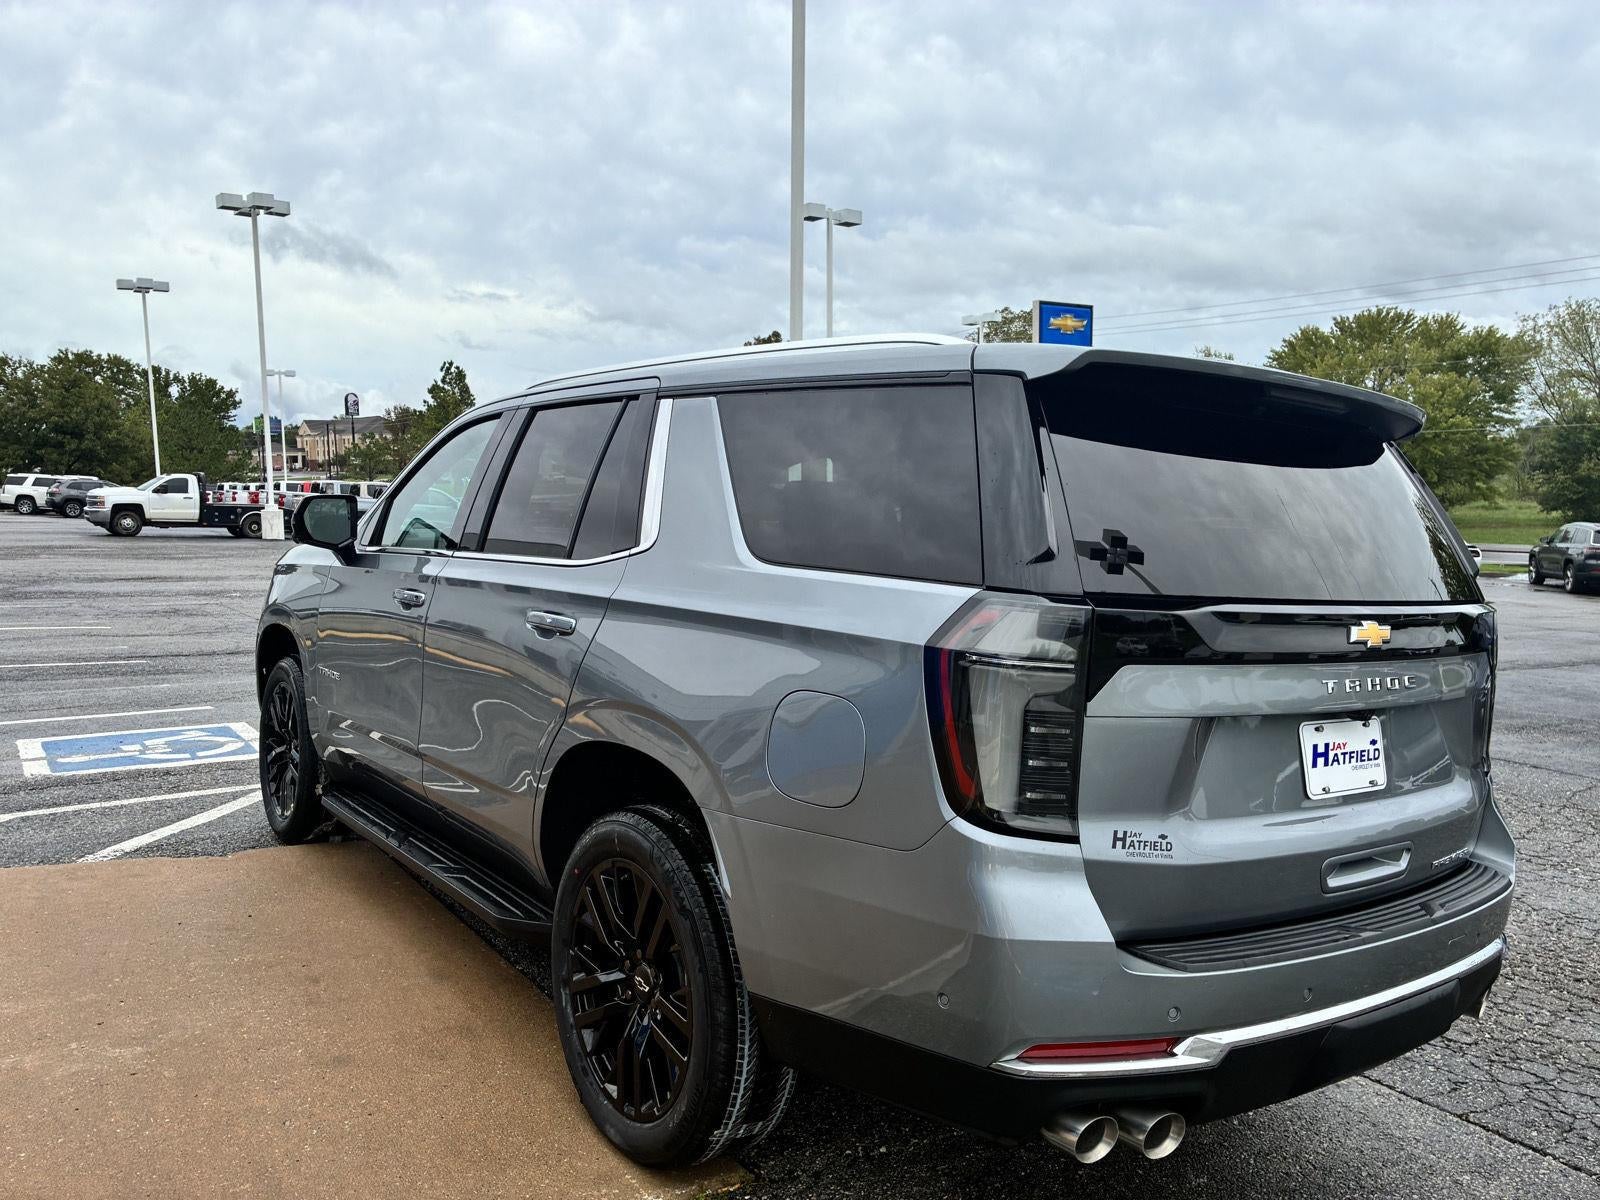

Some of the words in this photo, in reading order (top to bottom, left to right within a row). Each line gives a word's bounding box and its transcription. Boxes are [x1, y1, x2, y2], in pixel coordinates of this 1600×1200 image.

[1322, 675, 1417, 694] TAHOE
[1330, 742, 1347, 751] JAY
[1311, 742, 1380, 768] HATFIELD
[1111, 830, 1173, 852] HATFIELD
[1128, 831, 1142, 839] JAY
[1126, 851, 1154, 859] CHEVROLET
